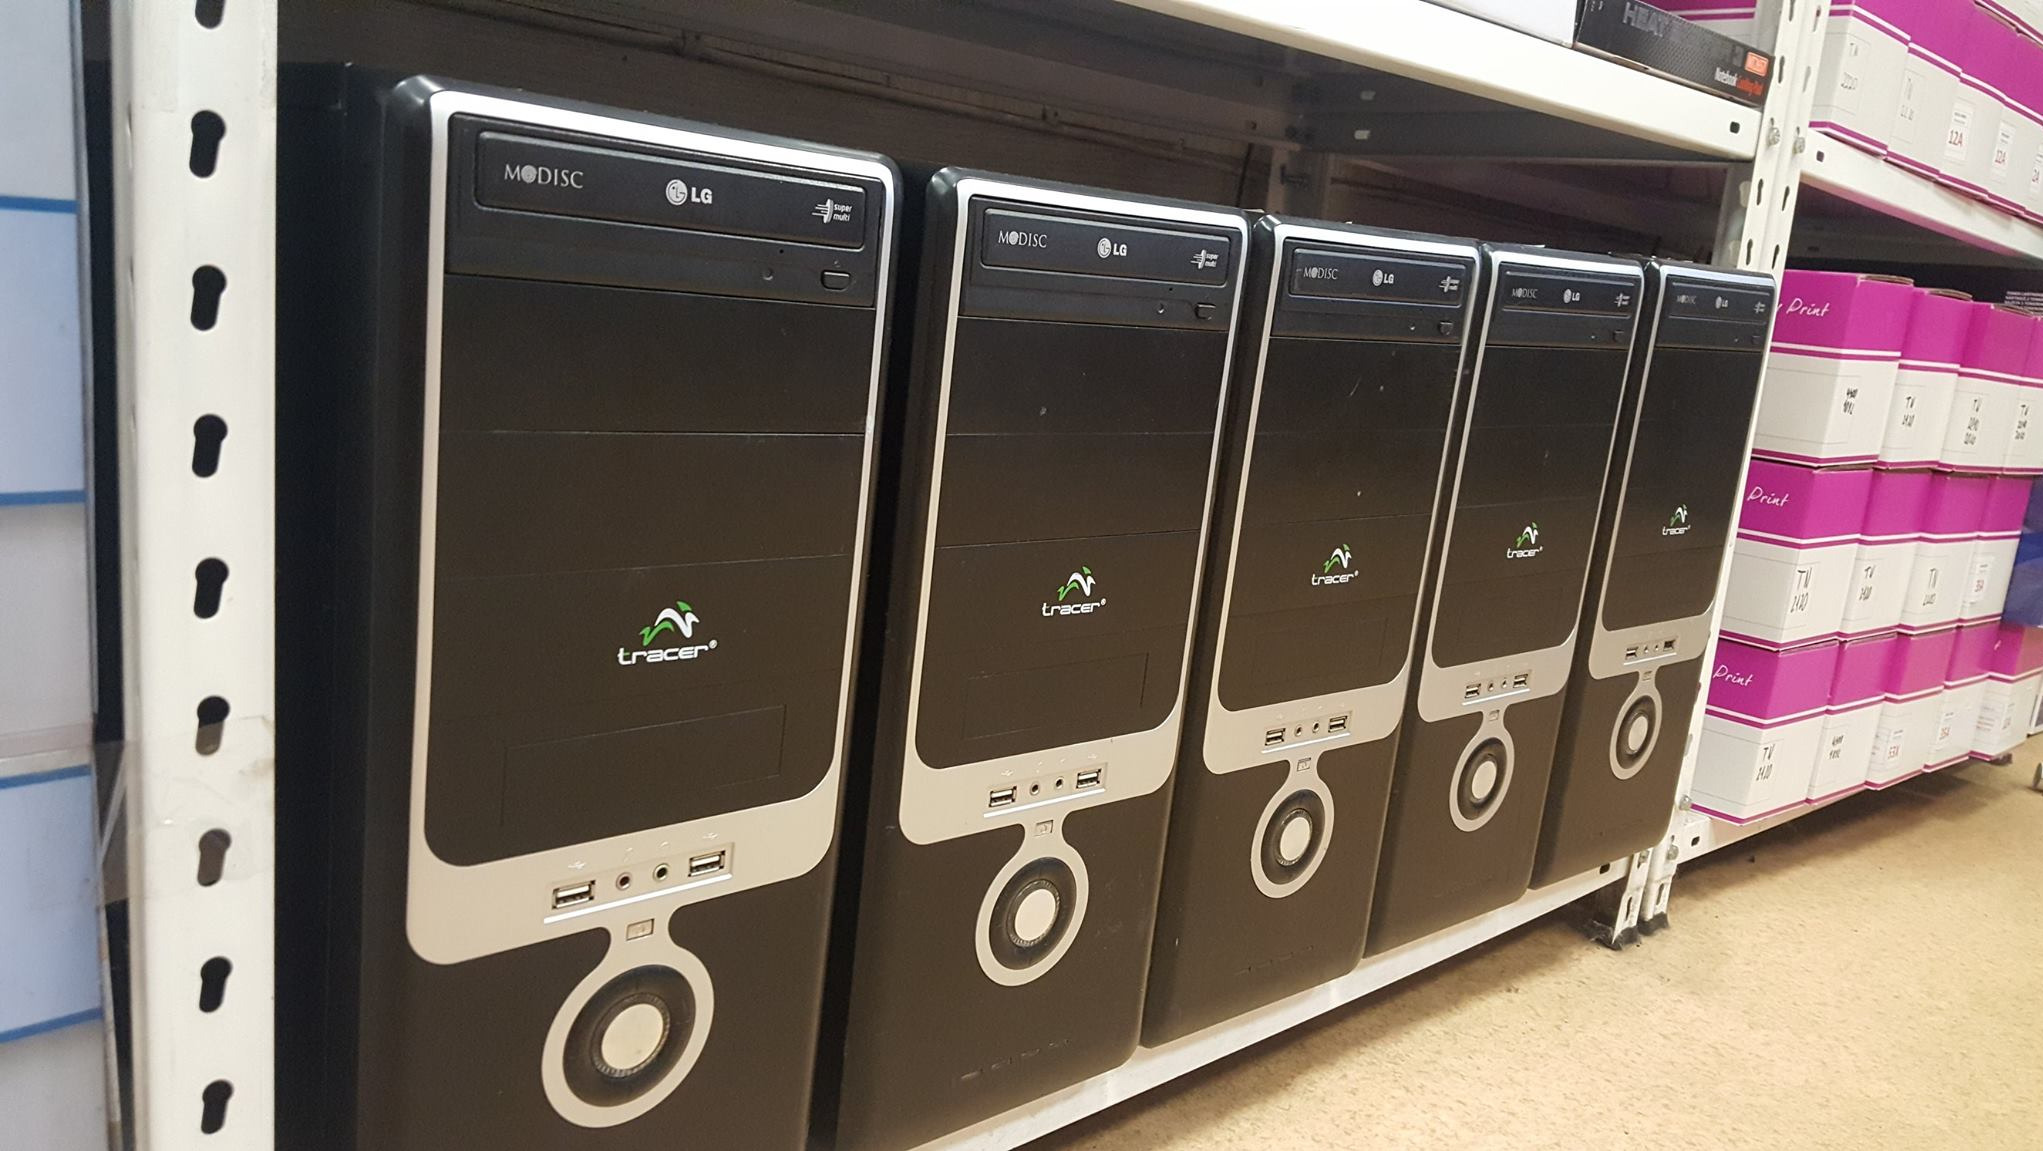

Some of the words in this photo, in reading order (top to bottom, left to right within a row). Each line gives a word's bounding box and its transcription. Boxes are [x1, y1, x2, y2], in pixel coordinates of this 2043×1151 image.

[690, 186, 713, 205] LG
[833, 203, 853, 213] super
[832, 212, 851, 222] multi
[1113, 243, 1128, 257] LG
[1383, 273, 1395, 284] LG
[1786, 297, 1830, 317] Print
[1747, 486, 1789, 507] Print
[1311, 573, 1355, 586] tracer
[1042, 602, 1101, 617] tracer
[617, 644, 709, 666] tracer
[1712, 664, 1753, 687] Print
